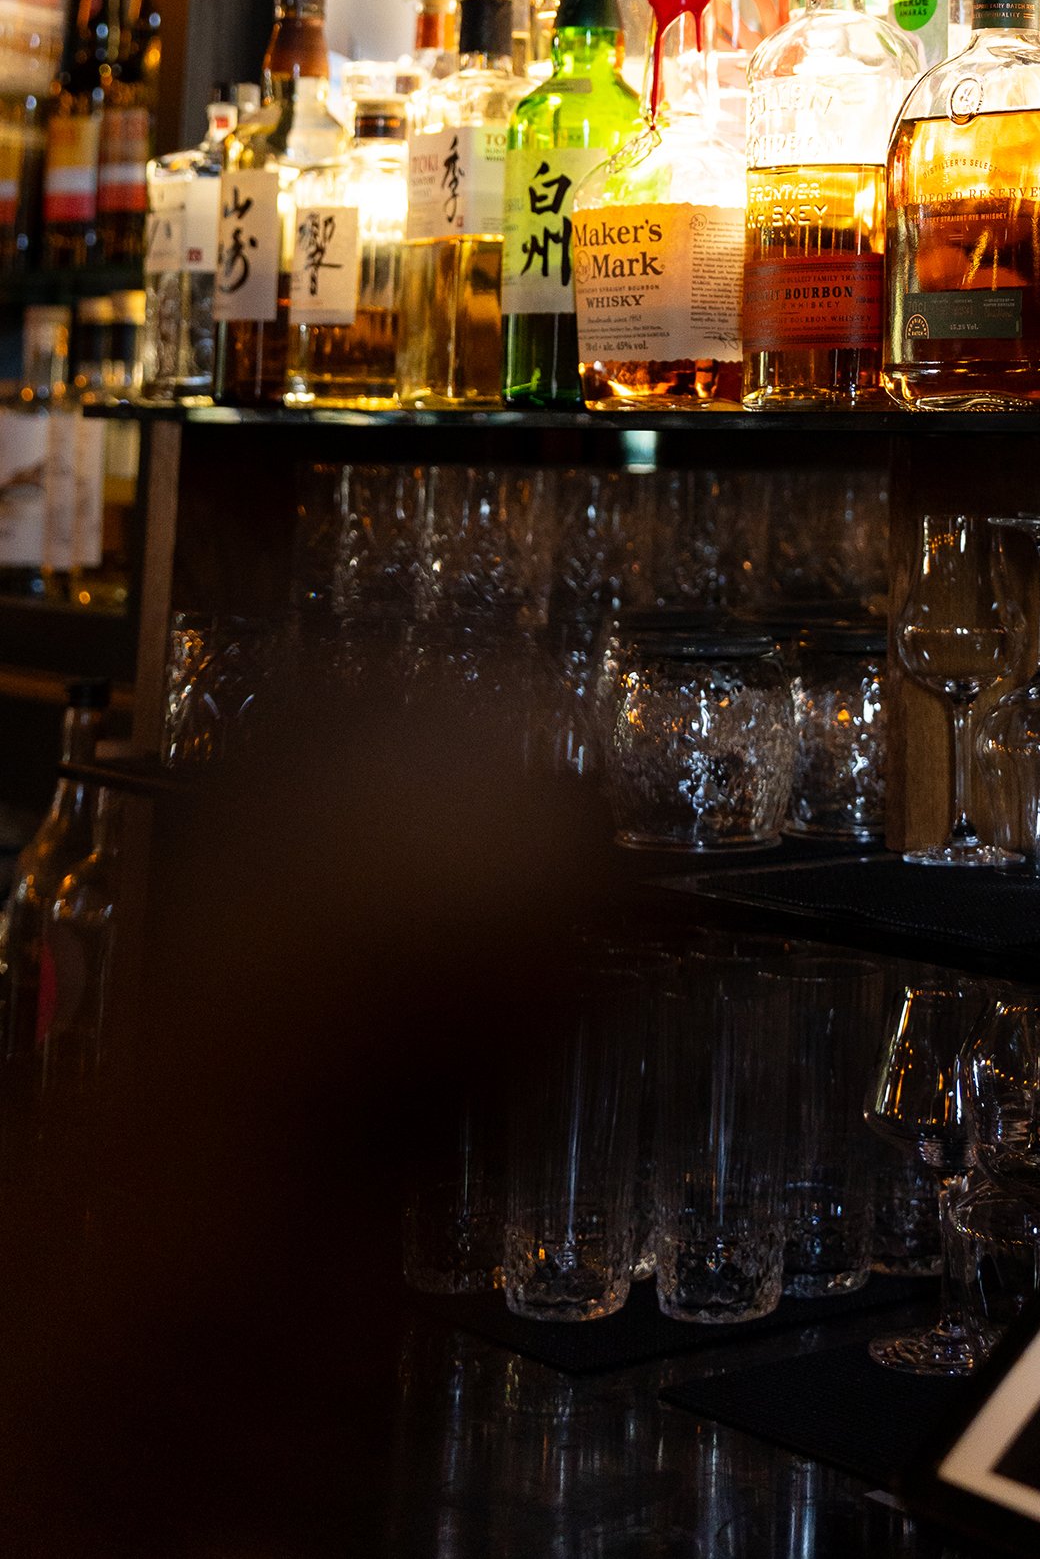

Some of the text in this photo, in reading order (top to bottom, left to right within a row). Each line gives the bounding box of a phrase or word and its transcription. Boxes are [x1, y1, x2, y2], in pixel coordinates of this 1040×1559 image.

[923, 158, 998, 179] DISTILLER'S SELECT
[969, 186, 1039, 199] RESERVE
[980, 212, 1008, 220] WHISKEY
[521, 161, 573, 287] 白州
[573, 219, 664, 248] Maker's
[591, 252, 664, 279] Mark
[785, 286, 853, 300] BOURBON
[585, 294, 645, 309] WHISKY
[634, 340, 649, 350] vol.
